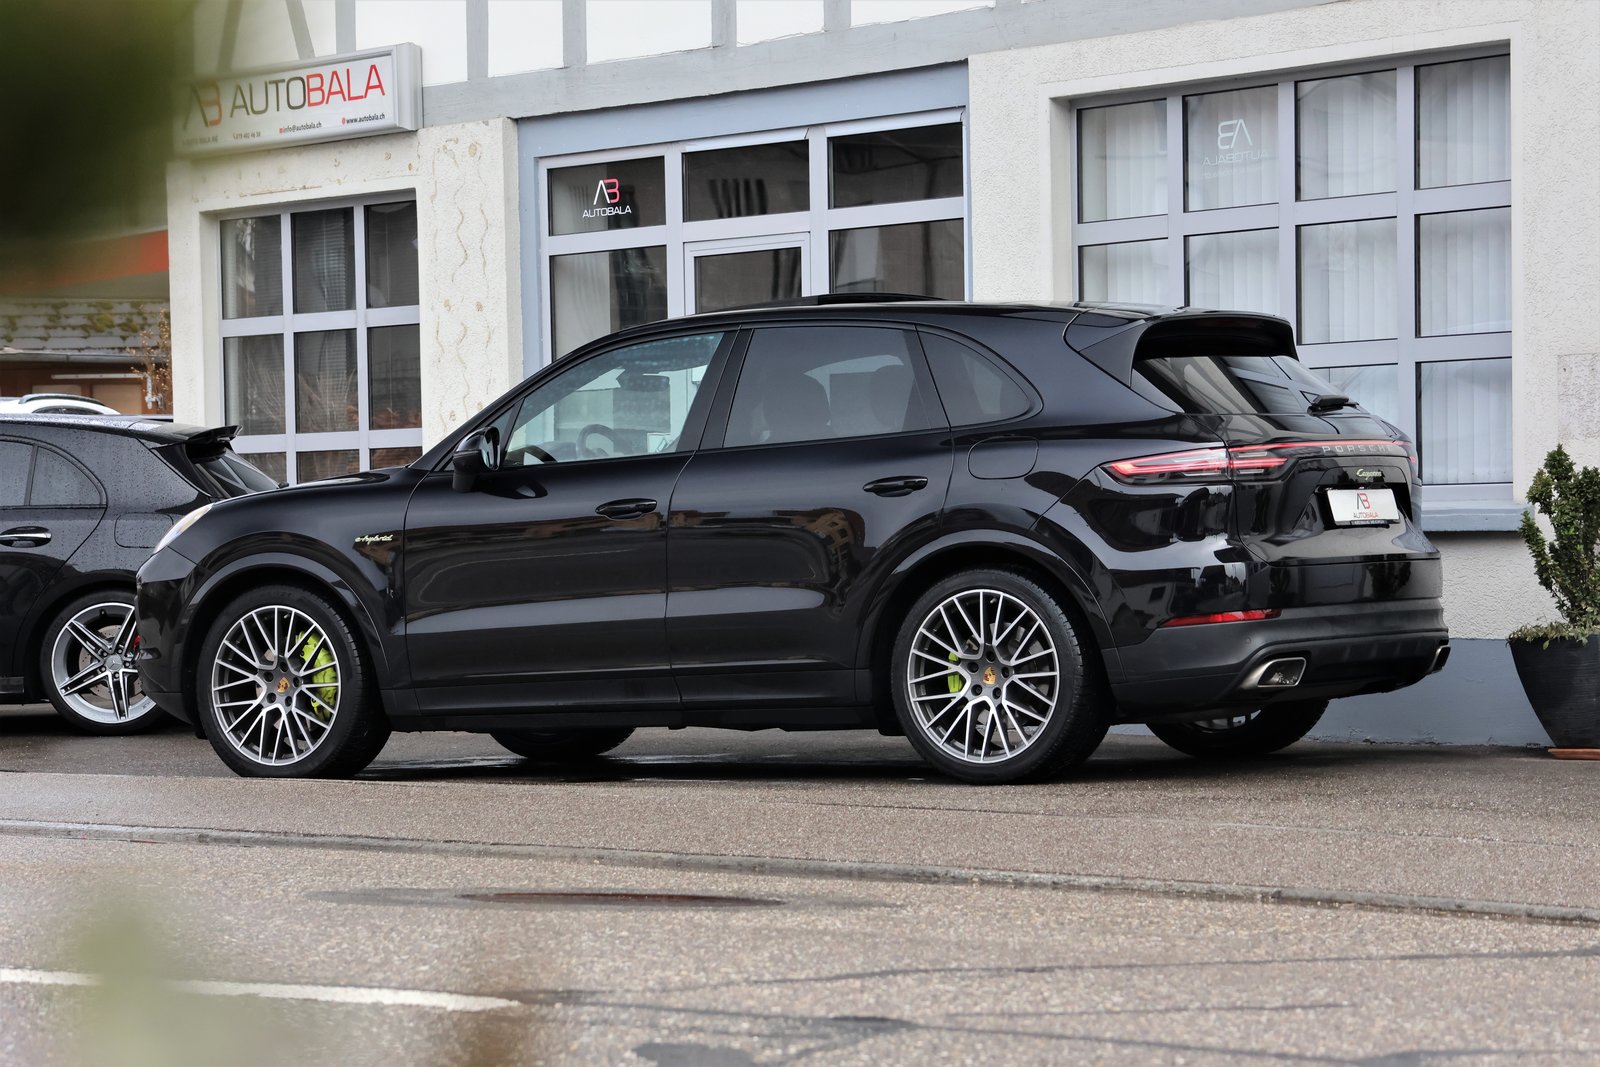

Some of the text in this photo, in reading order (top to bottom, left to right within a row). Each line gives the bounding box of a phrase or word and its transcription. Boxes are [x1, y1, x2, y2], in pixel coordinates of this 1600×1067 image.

[230, 64, 386, 118] AUTOBALA
[346, 112, 386, 124] www.autobala.ch
[283, 121, 323, 133] info@autobala.ch
[582, 205, 632, 218] AUTOBALA
